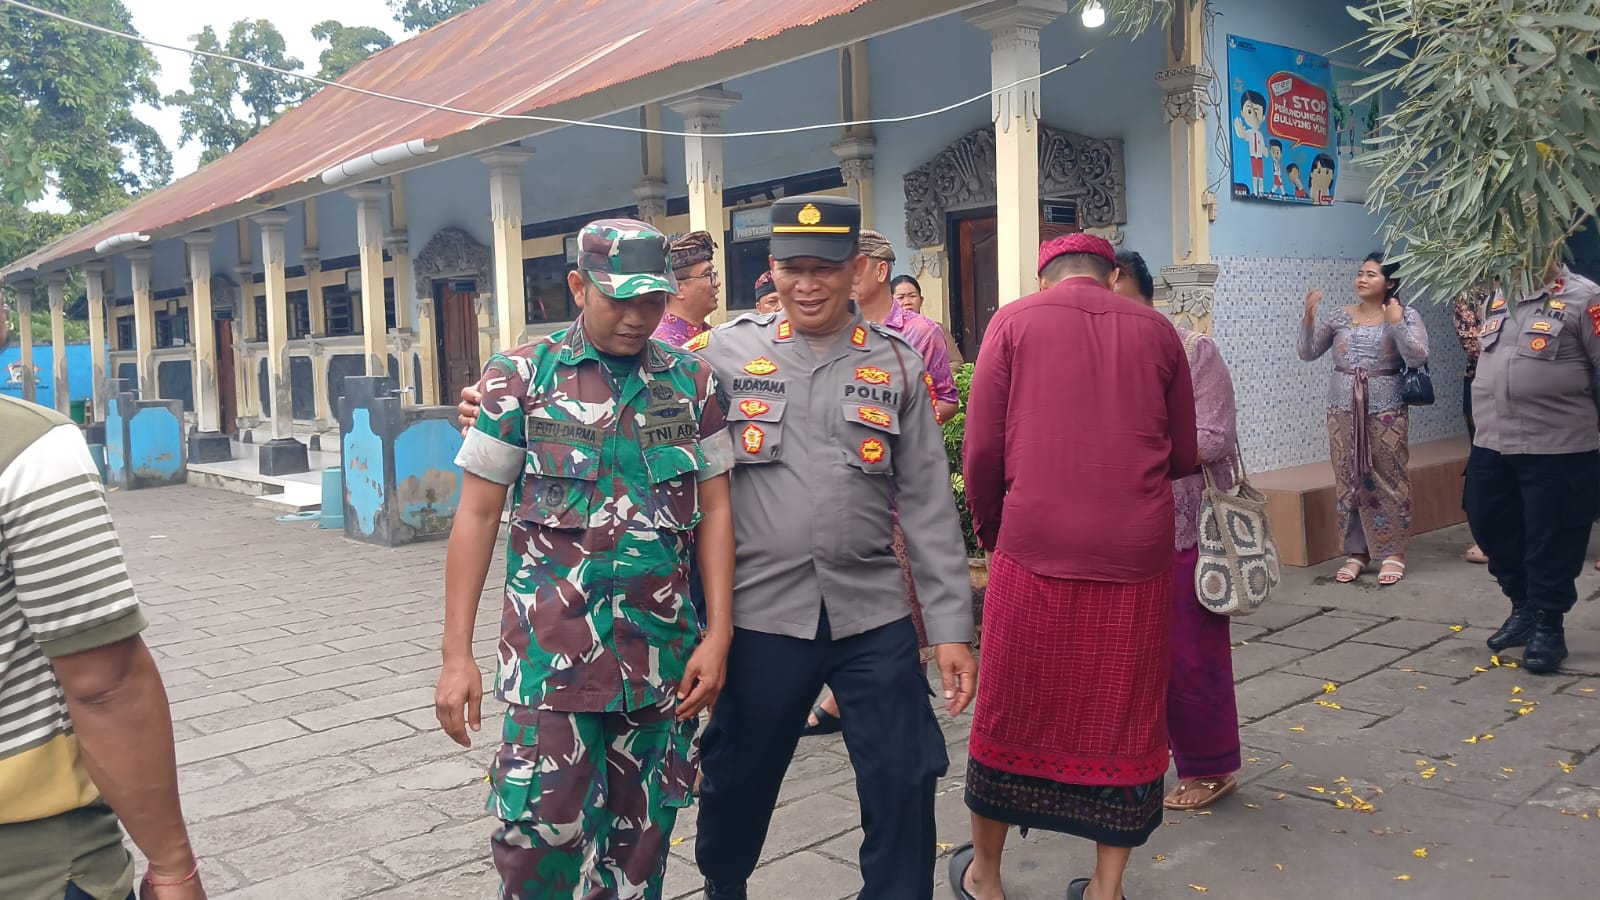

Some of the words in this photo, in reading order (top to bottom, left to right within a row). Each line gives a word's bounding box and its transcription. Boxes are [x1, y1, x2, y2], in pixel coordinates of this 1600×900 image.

[1292, 95, 1326, 114] STOP
[1273, 113, 1312, 130] BULLYING
[1534, 308, 1565, 321] PLRI
[733, 379, 786, 394] BUDAYANA
[844, 384, 898, 405] POLRI
[536, 421, 560, 434] PUTU
[562, 425, 596, 443] DARMA
[646, 426, 672, 443] TNI
